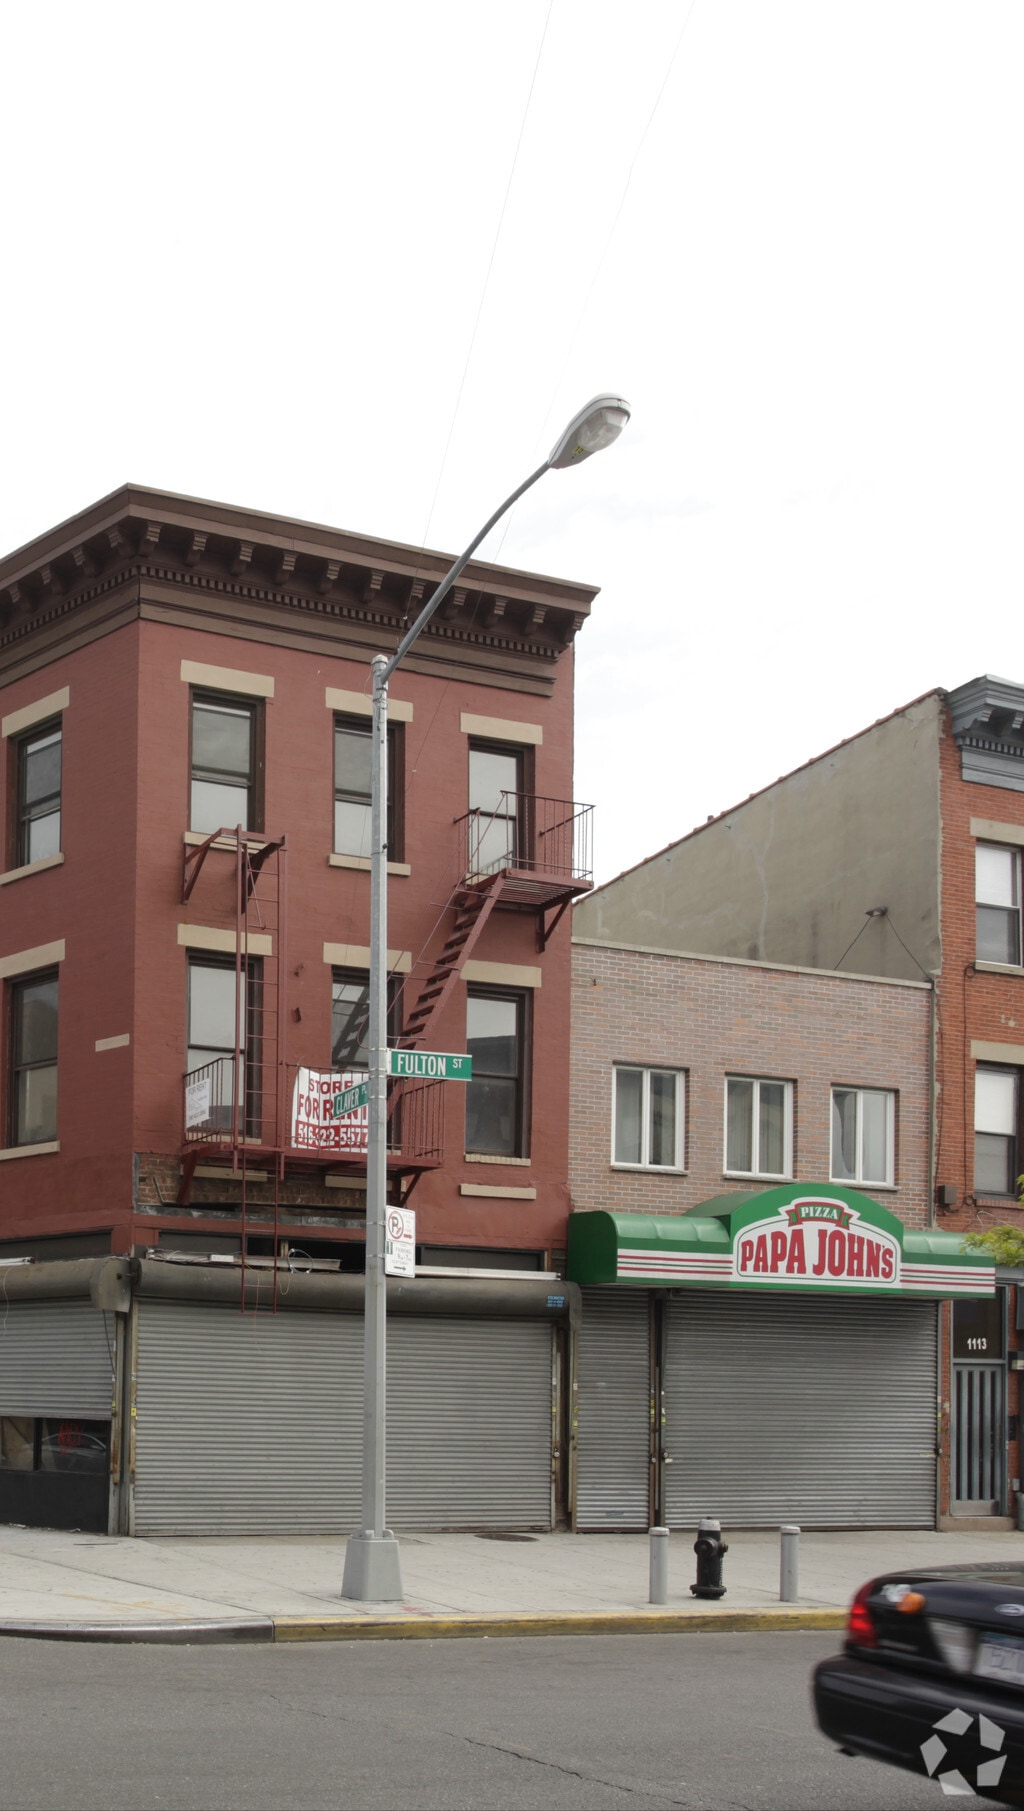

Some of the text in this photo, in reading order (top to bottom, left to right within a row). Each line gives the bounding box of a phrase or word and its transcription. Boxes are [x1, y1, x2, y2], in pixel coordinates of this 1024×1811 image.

[397, 1053, 463, 1076] FULTON ST
[309, 1078, 354, 1095] STORE
[298, 1093, 320, 1120] FOR
[336, 1088, 360, 1115] CLAVER
[800, 1205, 839, 1220] PIZZA
[740, 1228, 894, 1279] PAPA JOHN'S
[967, 1337, 987, 1350] 1113
